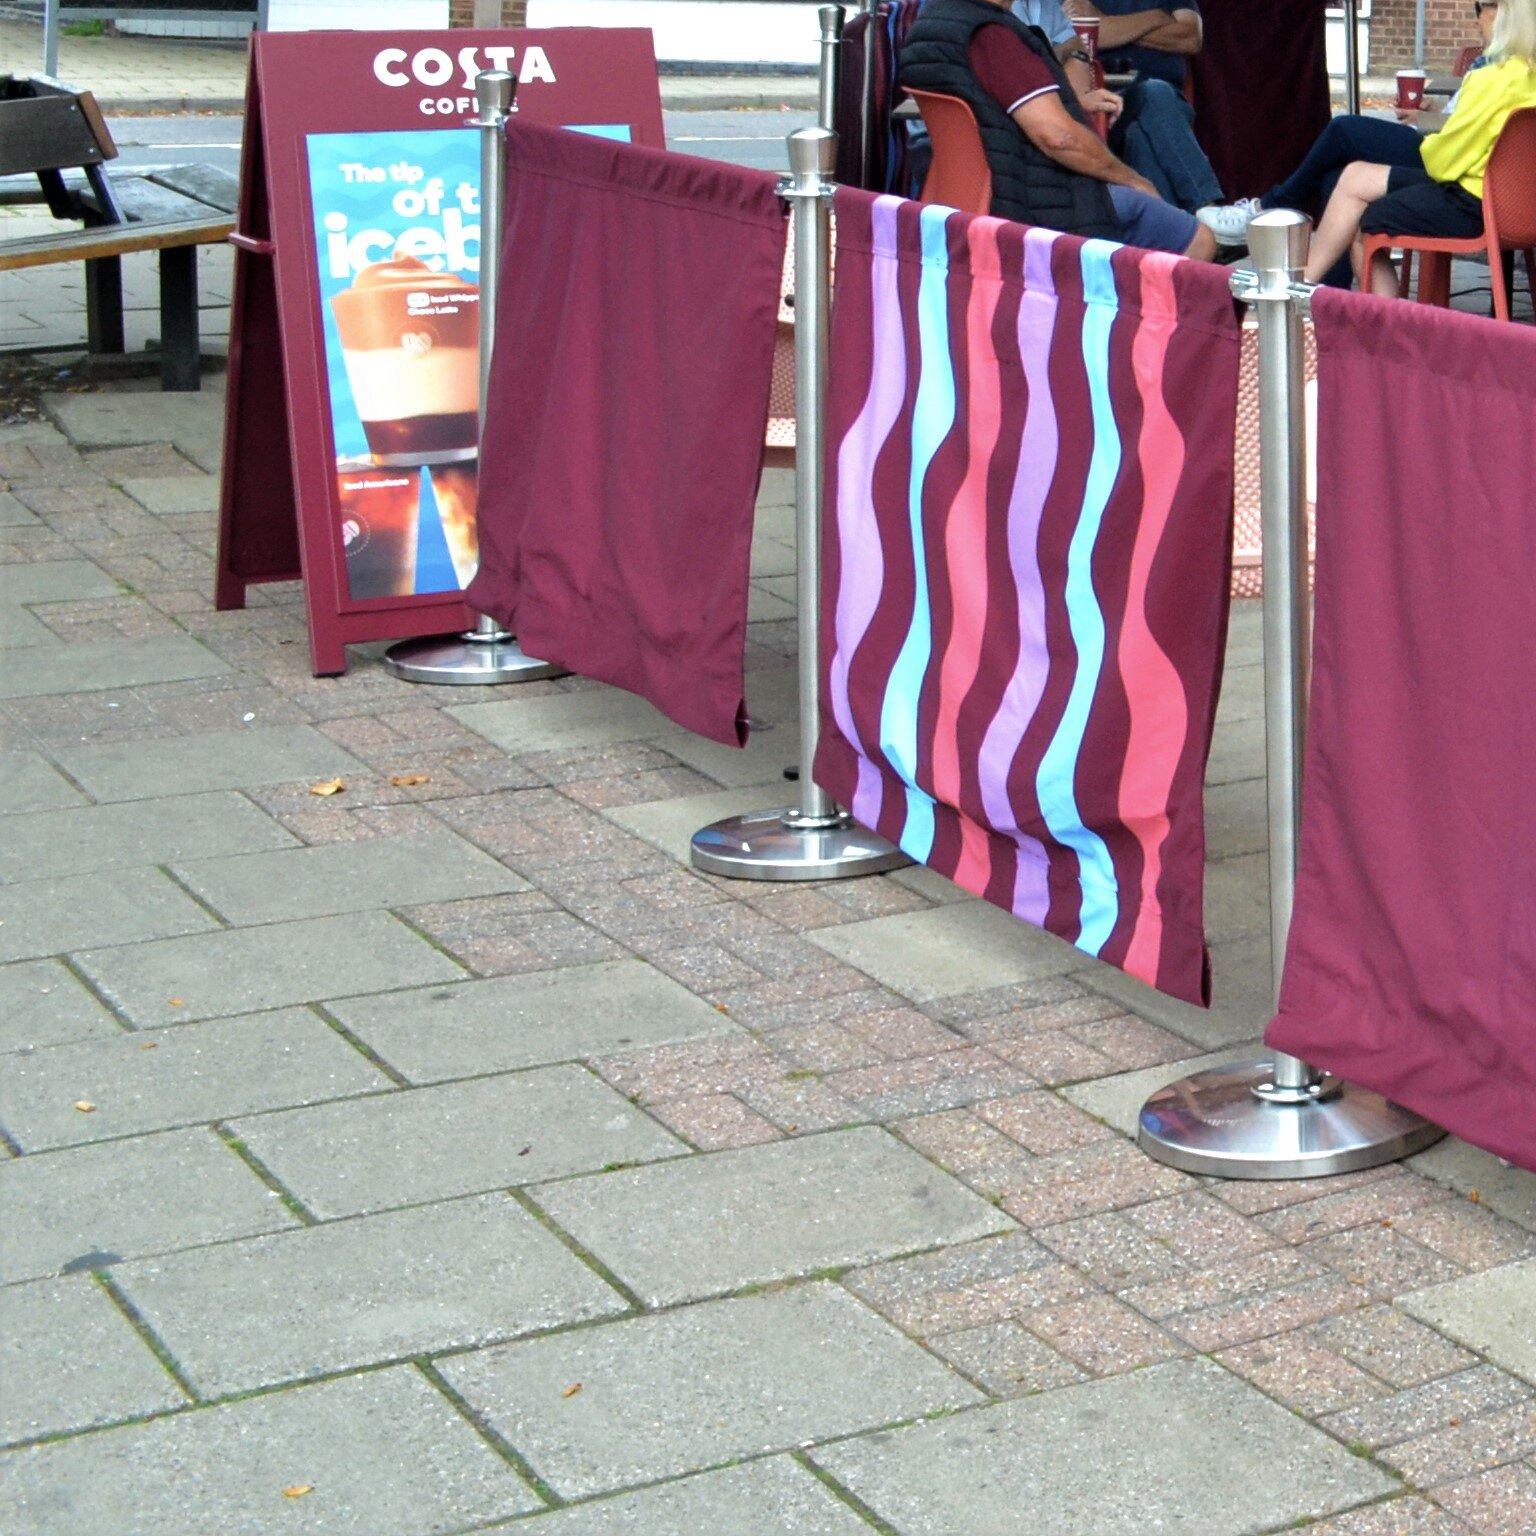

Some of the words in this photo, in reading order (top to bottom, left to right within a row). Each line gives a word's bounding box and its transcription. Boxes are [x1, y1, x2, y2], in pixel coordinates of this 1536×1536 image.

[373, 46, 557, 91] COSTA
[339, 162, 387, 183] The
[389, 161, 424, 186] tip
[392, 177, 445, 218] of
[323, 207, 482, 279] iceb
